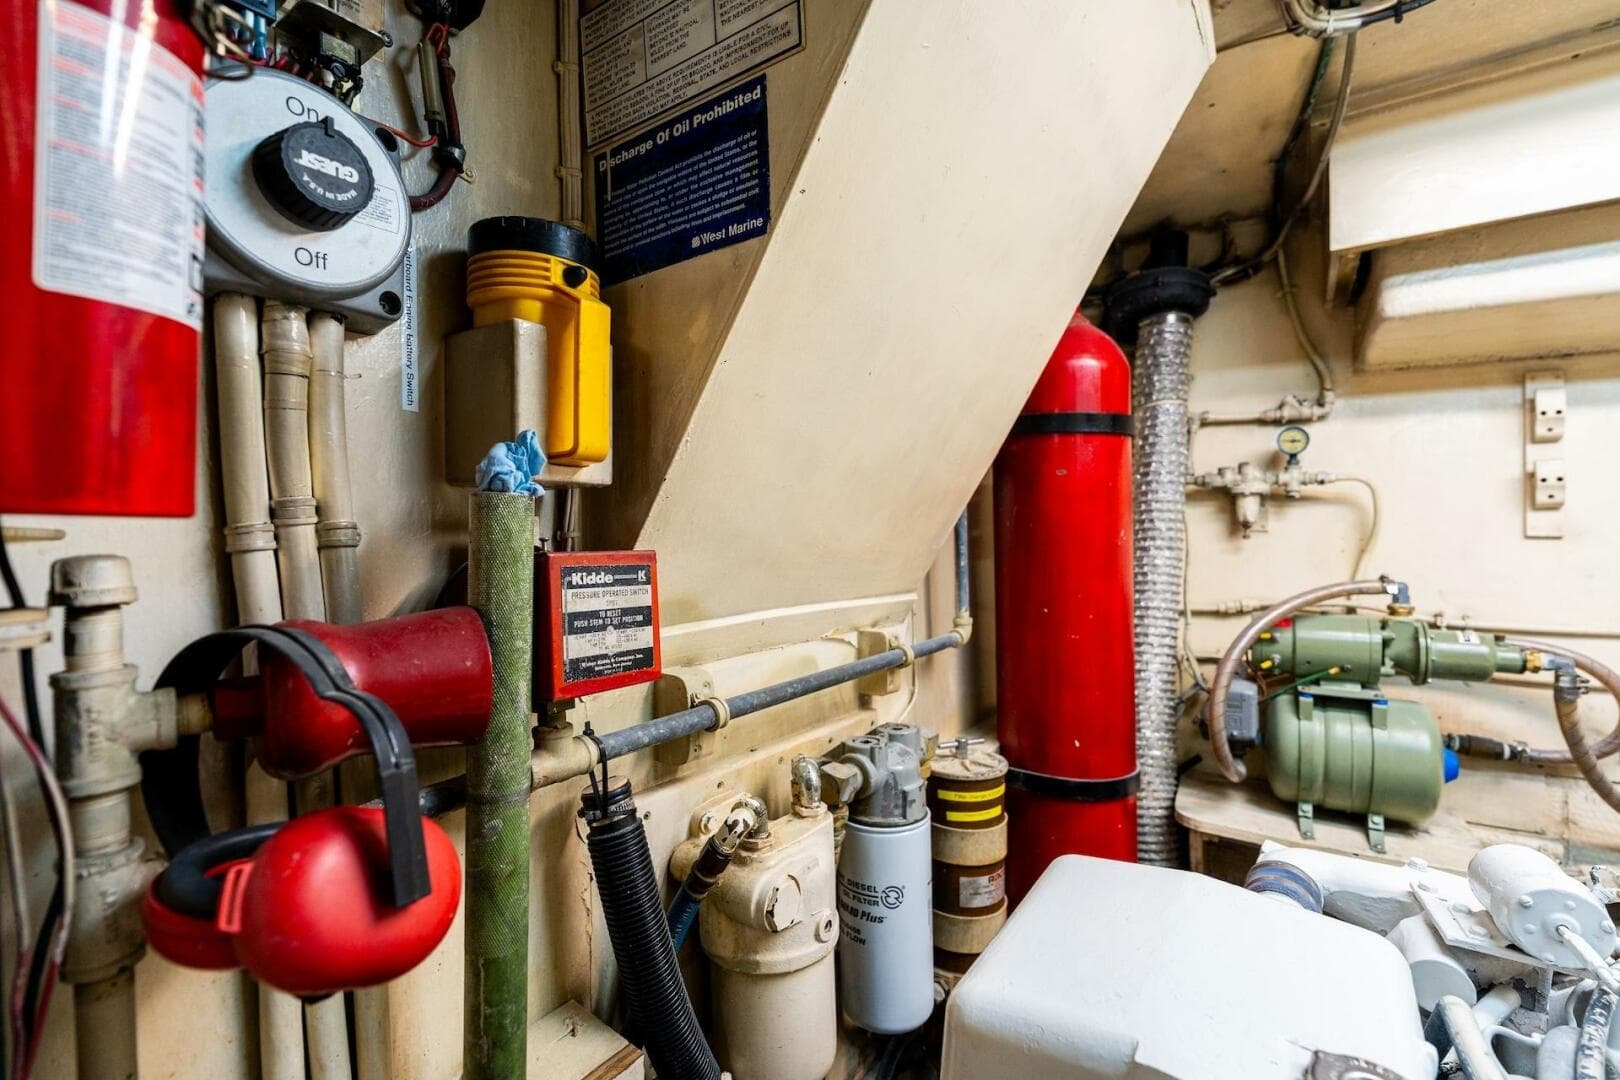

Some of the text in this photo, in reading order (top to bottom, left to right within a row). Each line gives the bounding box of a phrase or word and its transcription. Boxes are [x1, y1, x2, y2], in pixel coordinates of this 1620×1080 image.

[286, 96, 319, 122] On
[599, 85, 761, 172] Dscharge Of Oil Prohibited
[299, 149, 359, 183] GUEST
[701, 218, 763, 245] West Marine
[294, 247, 328, 271] Off
[406, 334, 414, 370] Battery
[406, 373, 414, 406] Switch
[571, 571, 614, 585] Kidde
[571, 588, 649, 600] PRESSURE OPERATED SWITCH
[606, 609, 621, 617] RESET
[847, 878, 879, 894] DIESEL
[852, 894, 880, 907] FILTER
[860, 910, 884, 924] Plus
